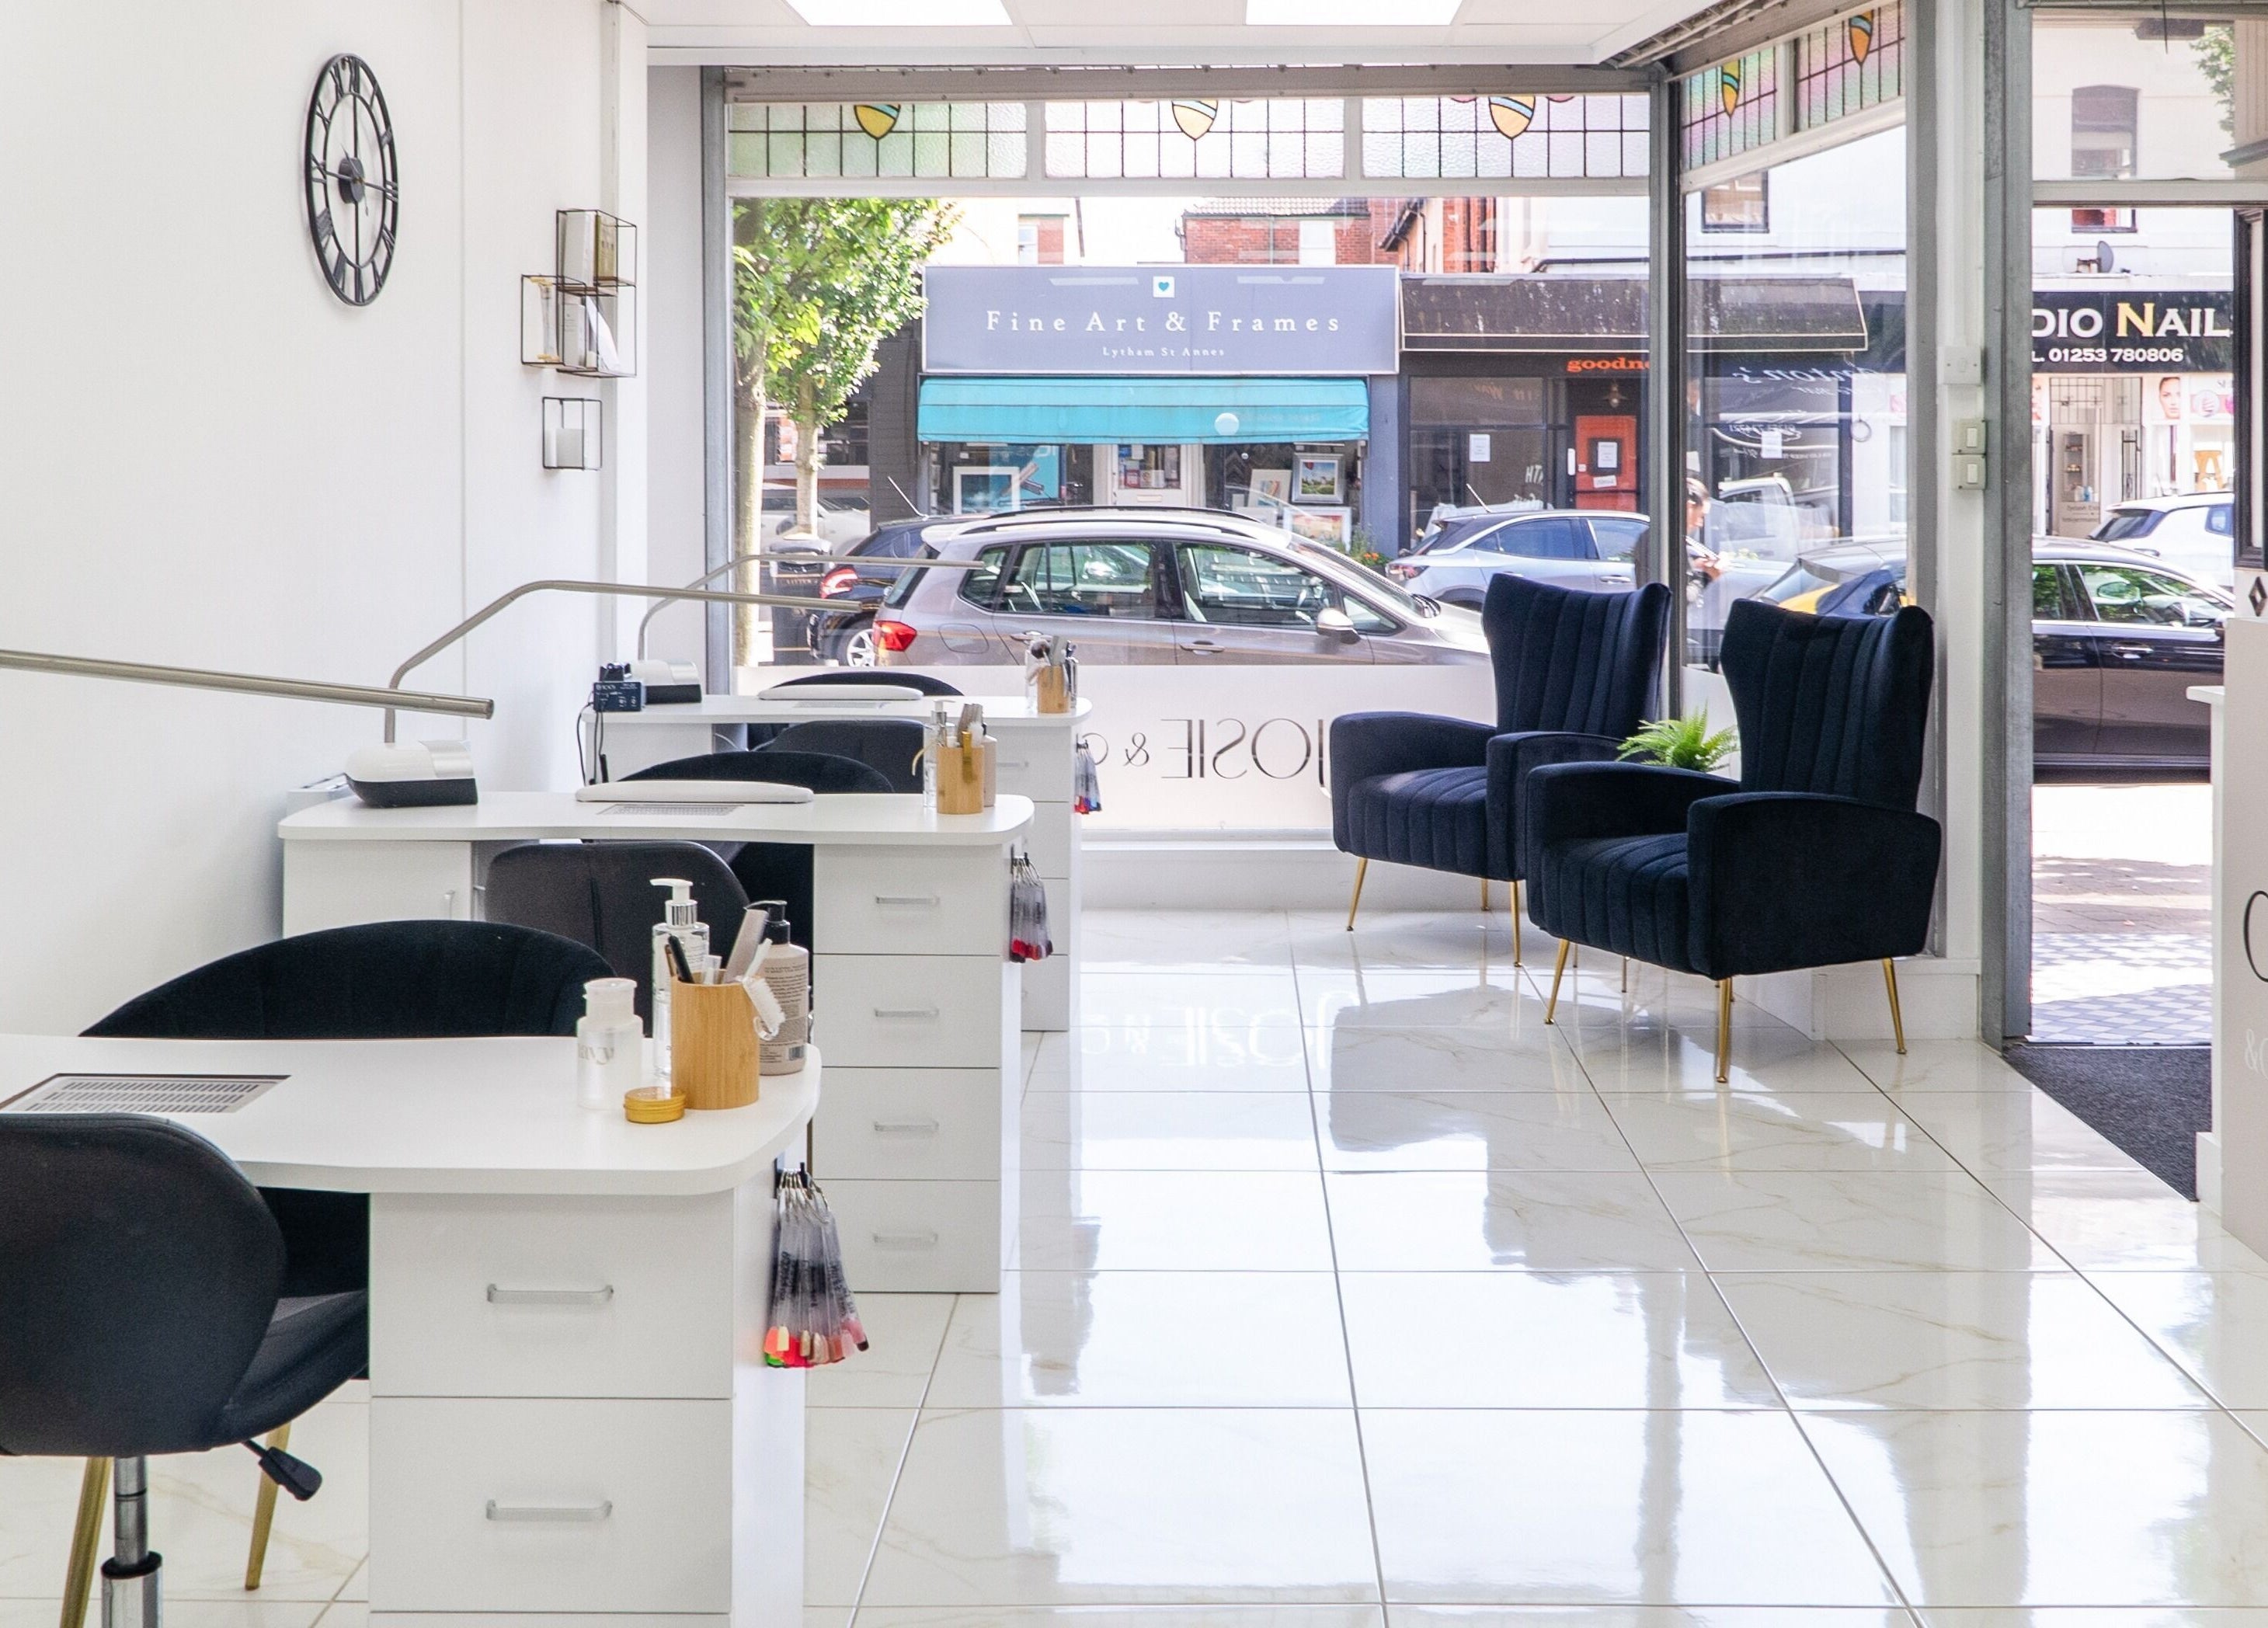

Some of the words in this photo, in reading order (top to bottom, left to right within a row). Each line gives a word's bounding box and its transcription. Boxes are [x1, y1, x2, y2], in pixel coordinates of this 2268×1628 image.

[986, 310, 1066, 332] Fine
[1085, 311, 1146, 332] Art
[1165, 311, 1187, 332] &
[1207, 310, 1339, 332] Frames
[2030, 308, 2103, 338] DIO
[2116, 302, 2233, 338] NAIL
[1102, 347, 1154, 358] Lytham
[1160, 347, 1175, 357] St
[1181, 347, 1225, 357] Annes
[2048, 348, 2107, 363] 01253
[2110, 348, 2184, 363] 780806
